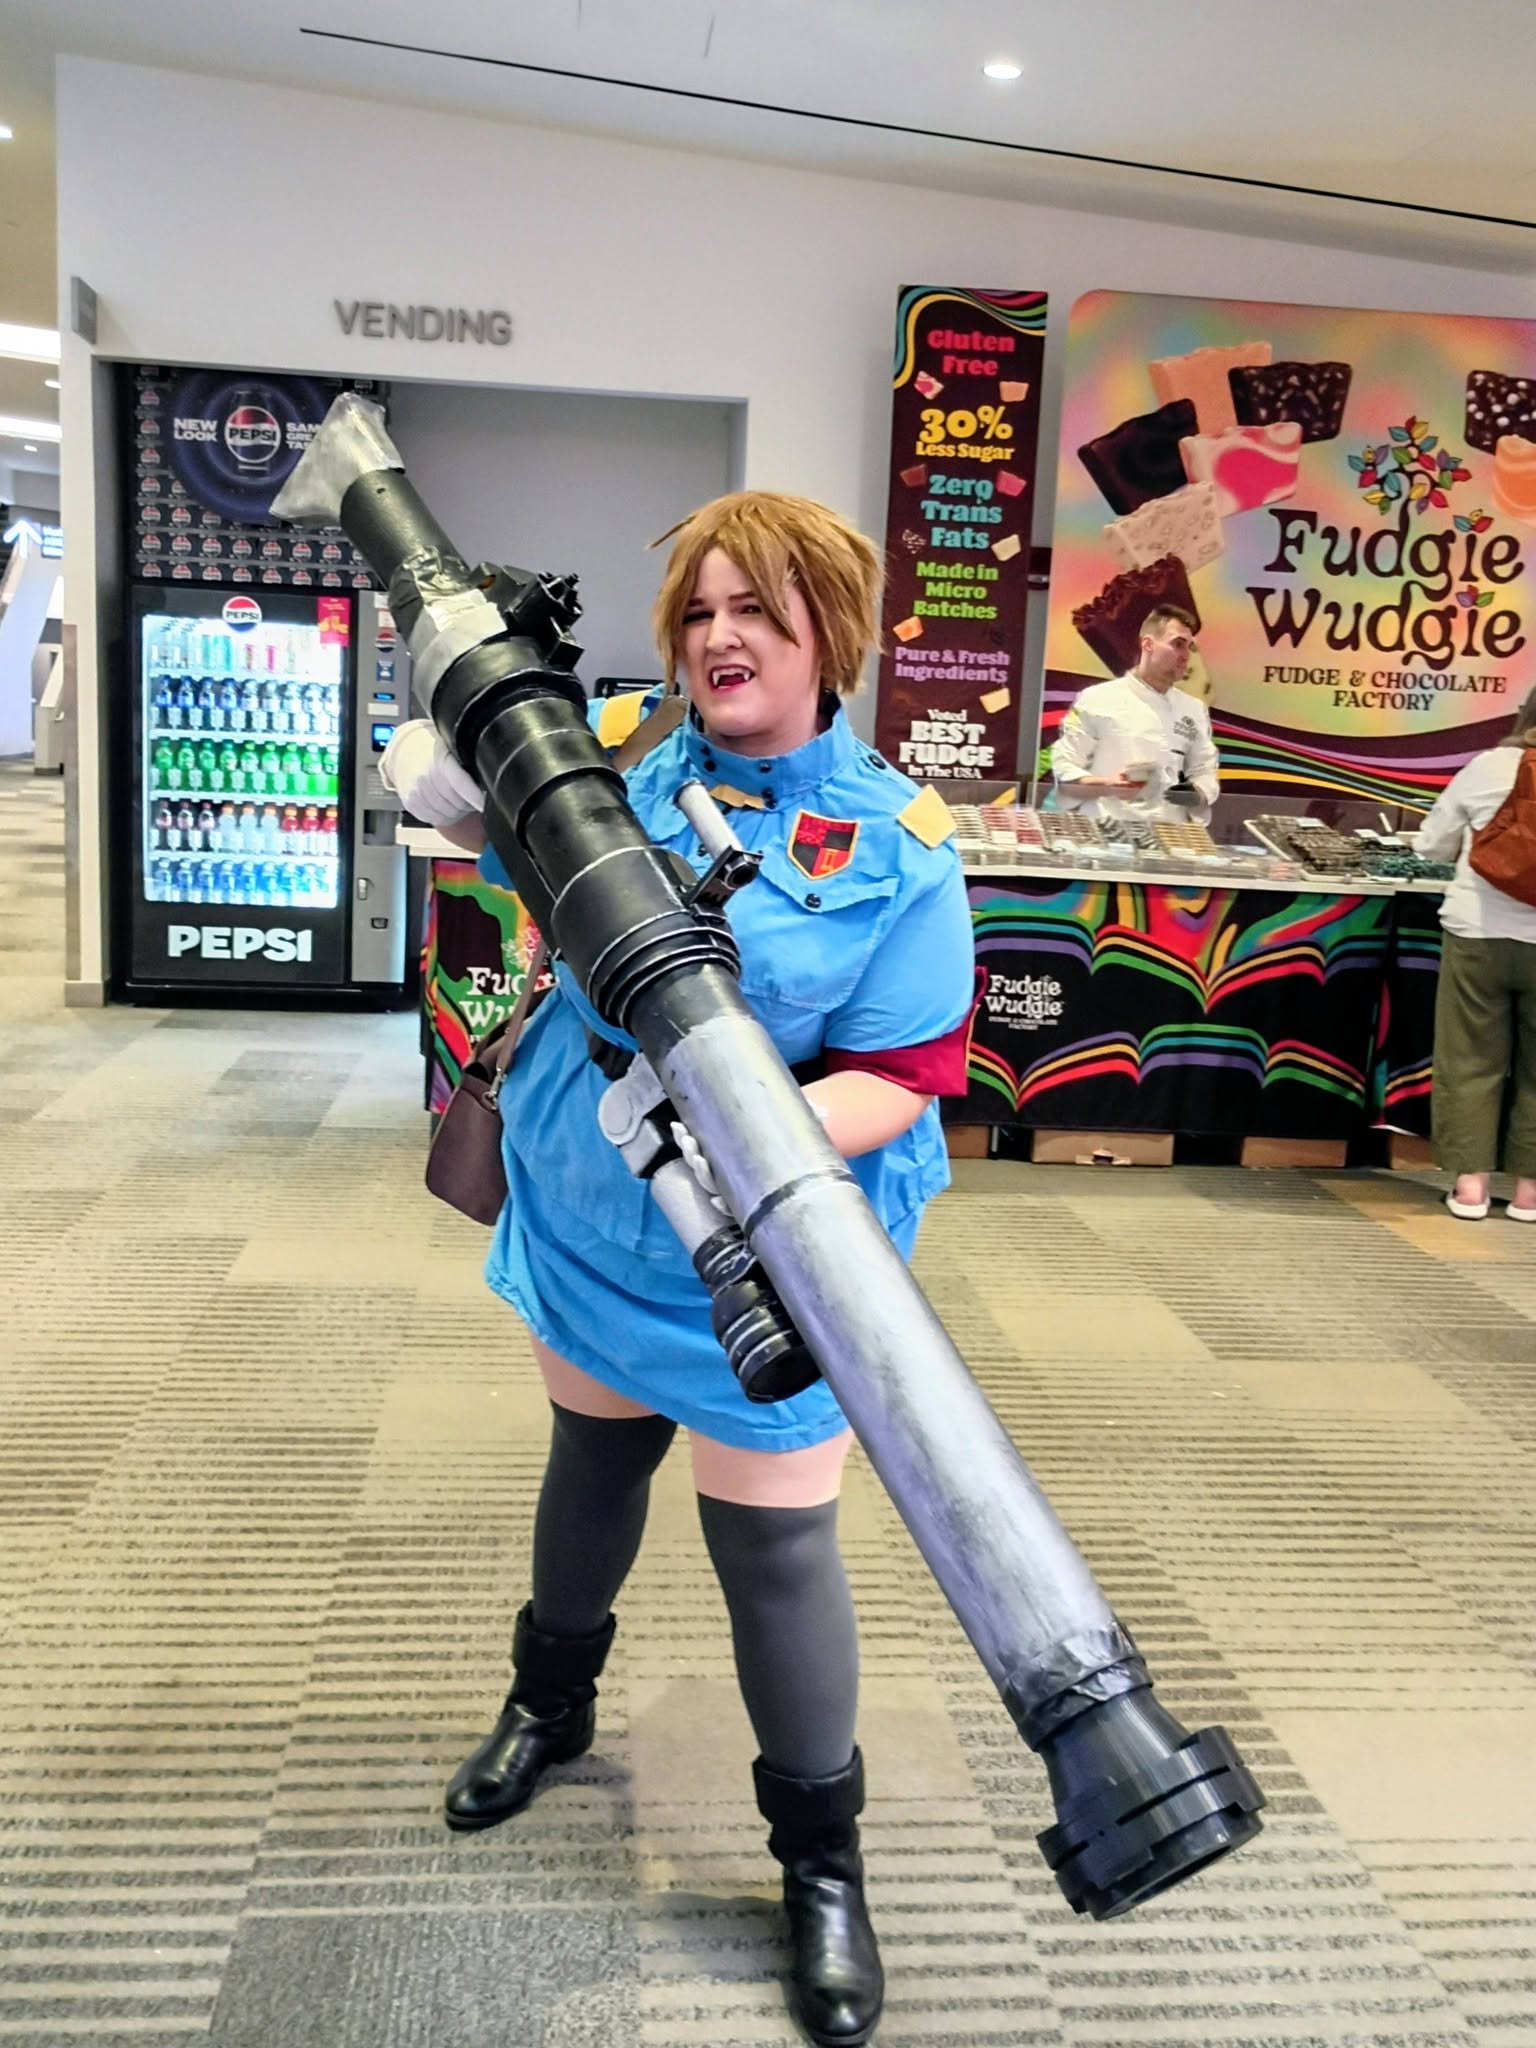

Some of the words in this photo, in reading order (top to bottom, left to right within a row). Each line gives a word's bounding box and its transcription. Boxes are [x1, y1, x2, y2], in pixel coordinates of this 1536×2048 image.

[334, 299, 512, 346] VENDING
[927, 329, 1016, 353] Gluten
[942, 355, 998, 376] Free
[173, 417, 218, 432] NEW
[228, 428, 277, 442] PEPSI
[285, 421, 321, 433] SAM
[919, 405, 1013, 444] 30%
[173, 430, 218, 442] LOOK
[285, 432, 313, 441] GRE
[915, 441, 956, 458] Less
[959, 442, 1015, 463] Sugar
[928, 474, 994, 499] Zero
[920, 500, 1003, 524] Trans
[930, 527, 989, 550] Fats
[1263, 505, 1525, 602] Fudgie
[916, 561, 975, 580] Made
[976, 563, 999, 581] in
[925, 581, 988, 599] Micro
[226, 610, 260, 620] PEPSI
[913, 601, 998, 620] Batches
[1245, 580, 1526, 670] Wudgie
[895, 646, 941, 663] Pure
[941, 648, 958, 663] &
[958, 649, 1010, 666] Fresh
[895, 663, 1009, 683] Ingredients
[1263, 665, 1341, 686] FUDGE
[1349, 670, 1365, 687] &
[1371, 672, 1507, 694] CHOCOLATE
[1332, 690, 1435, 711] FACTORY
[927, 708, 967, 722] Voted
[910, 720, 986, 745] BEST
[898, 741, 995, 767] FUDGE
[907, 764, 924, 776] In
[924, 764, 952, 778] The
[953, 767, 983, 779] USA
[168, 925, 312, 962] PEPSI
[988, 974, 1063, 1000] Fudgie
[983, 994, 1063, 1019] Wudgie
